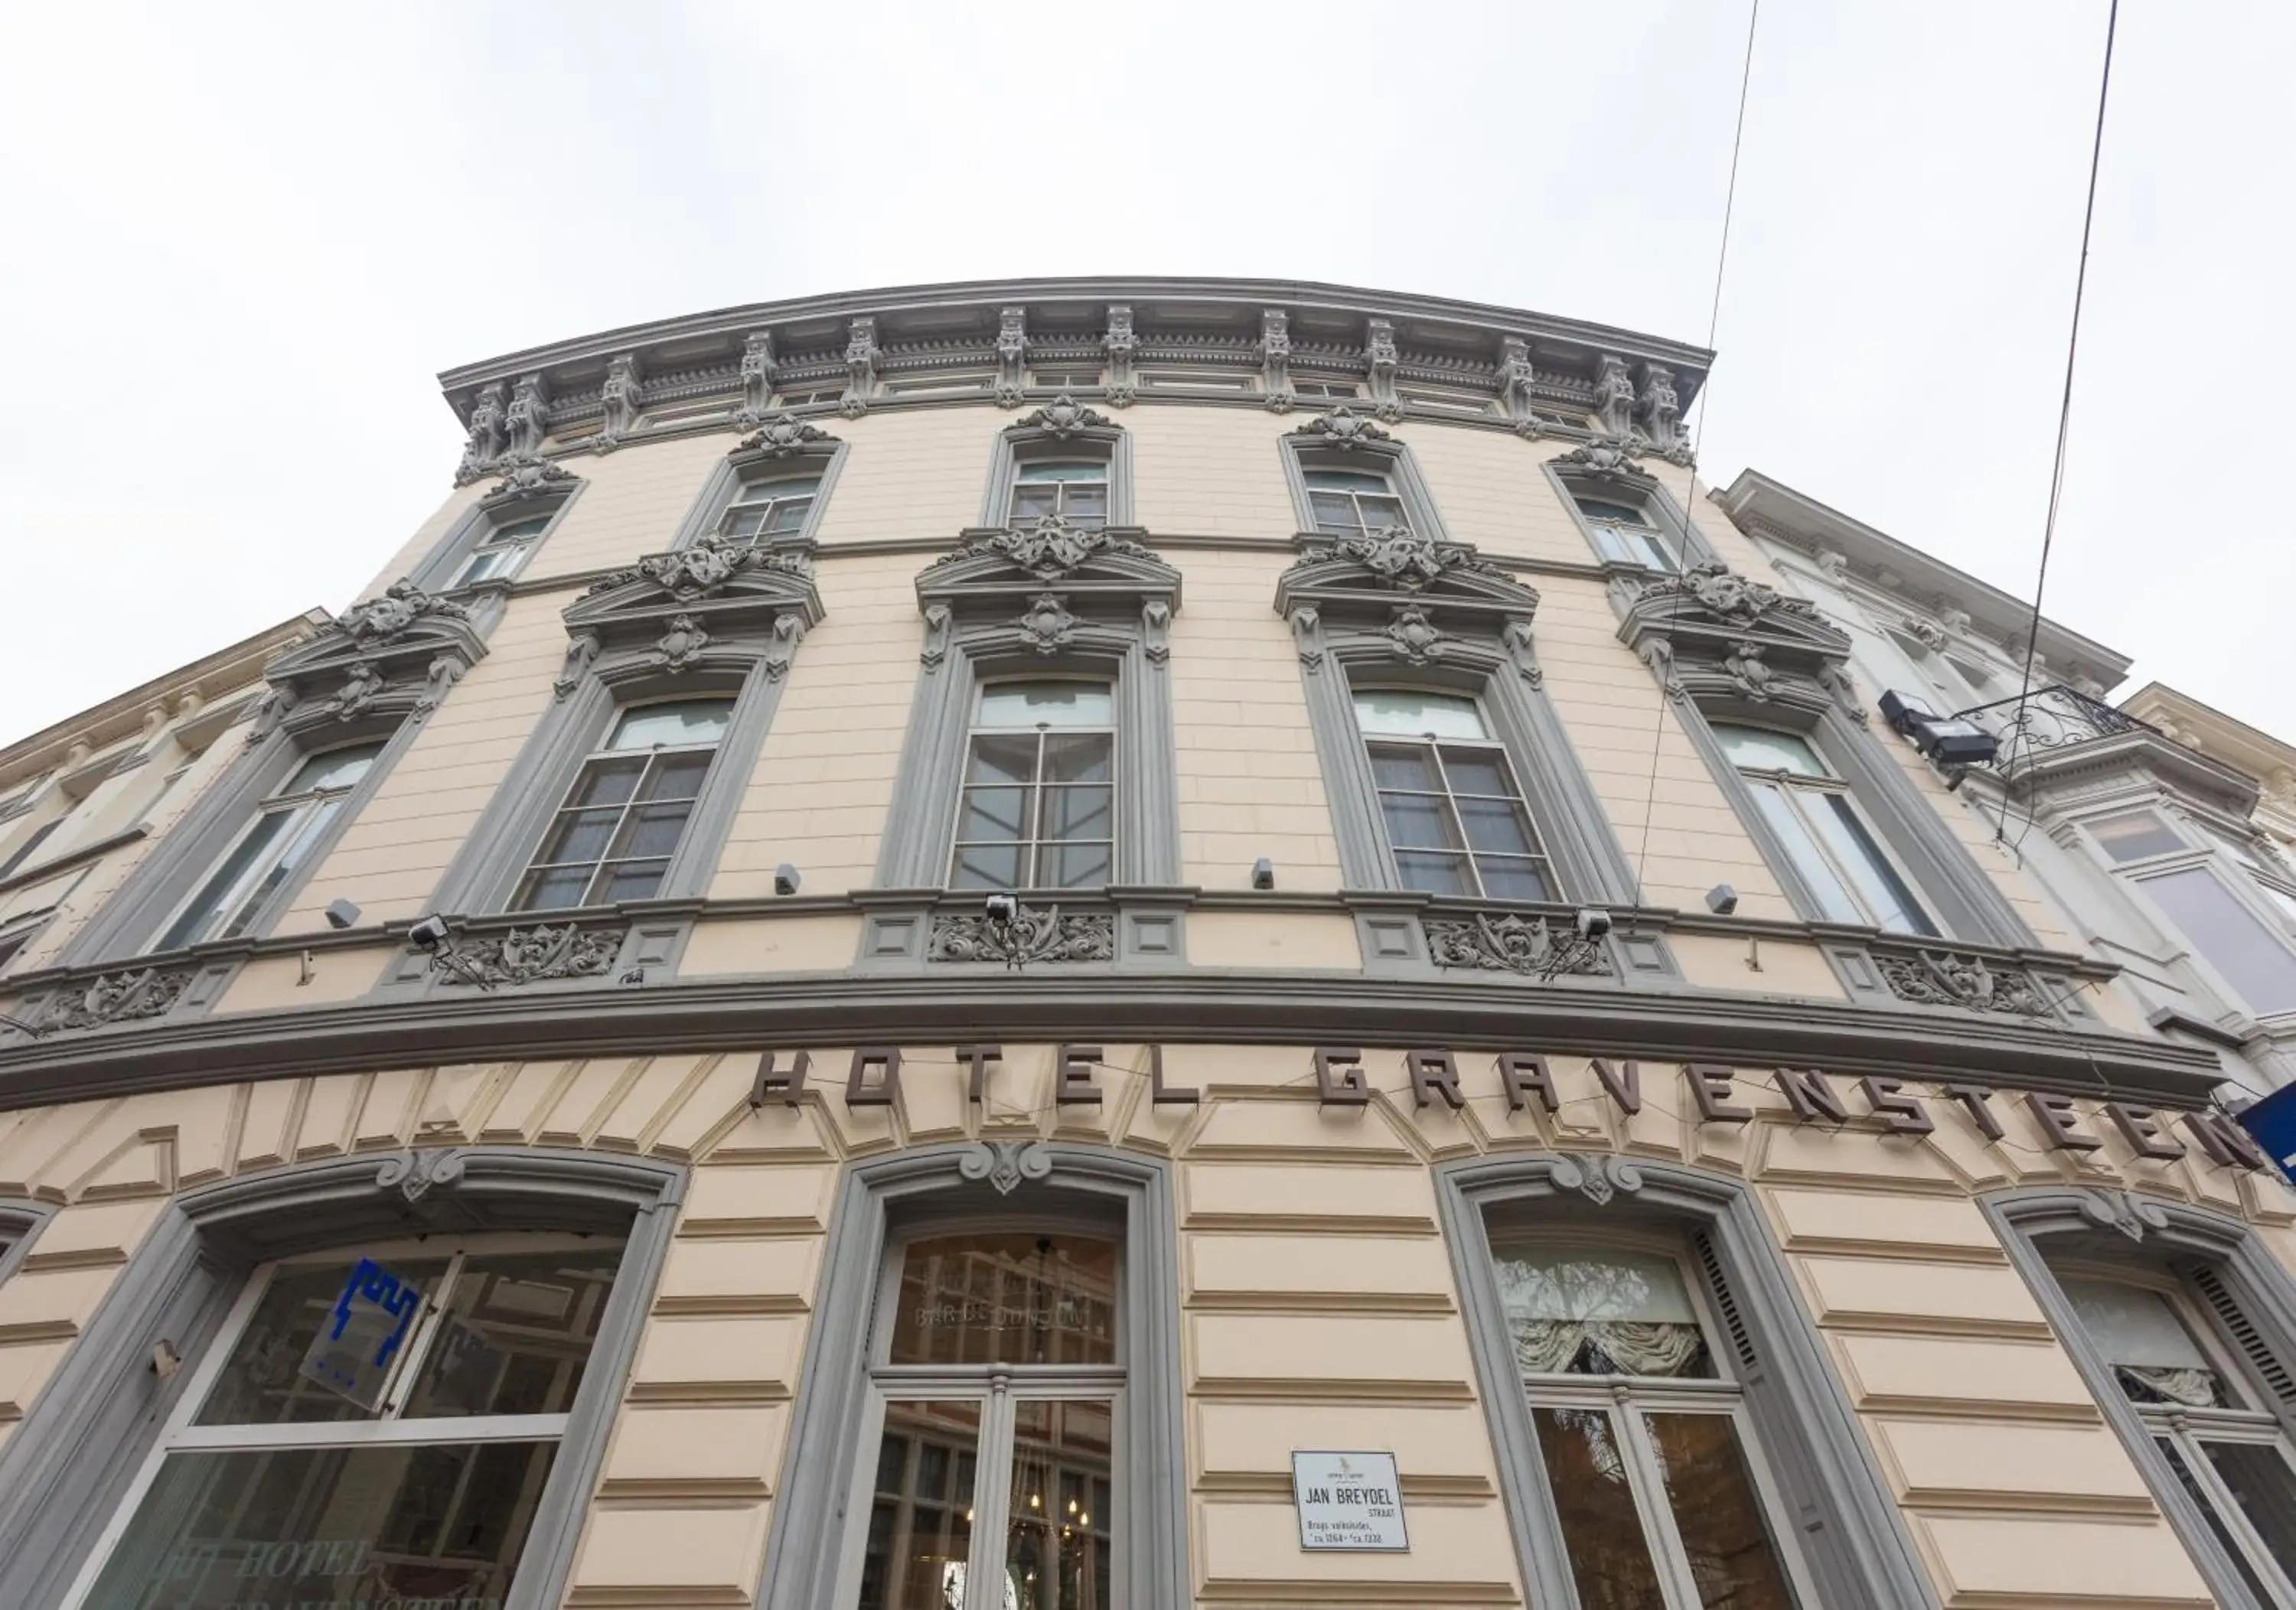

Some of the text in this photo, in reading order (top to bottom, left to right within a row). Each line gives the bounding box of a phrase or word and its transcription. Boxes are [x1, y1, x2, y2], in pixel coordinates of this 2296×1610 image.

[751, 1044, 2265, 1169] HOTEL GRAVENSTEEN
[1306, 1488, 1393, 1505] JAN BREYDEL
[1368, 1508, 1394, 1517] STRAAT
[239, 1540, 373, 1576] HOTEL
